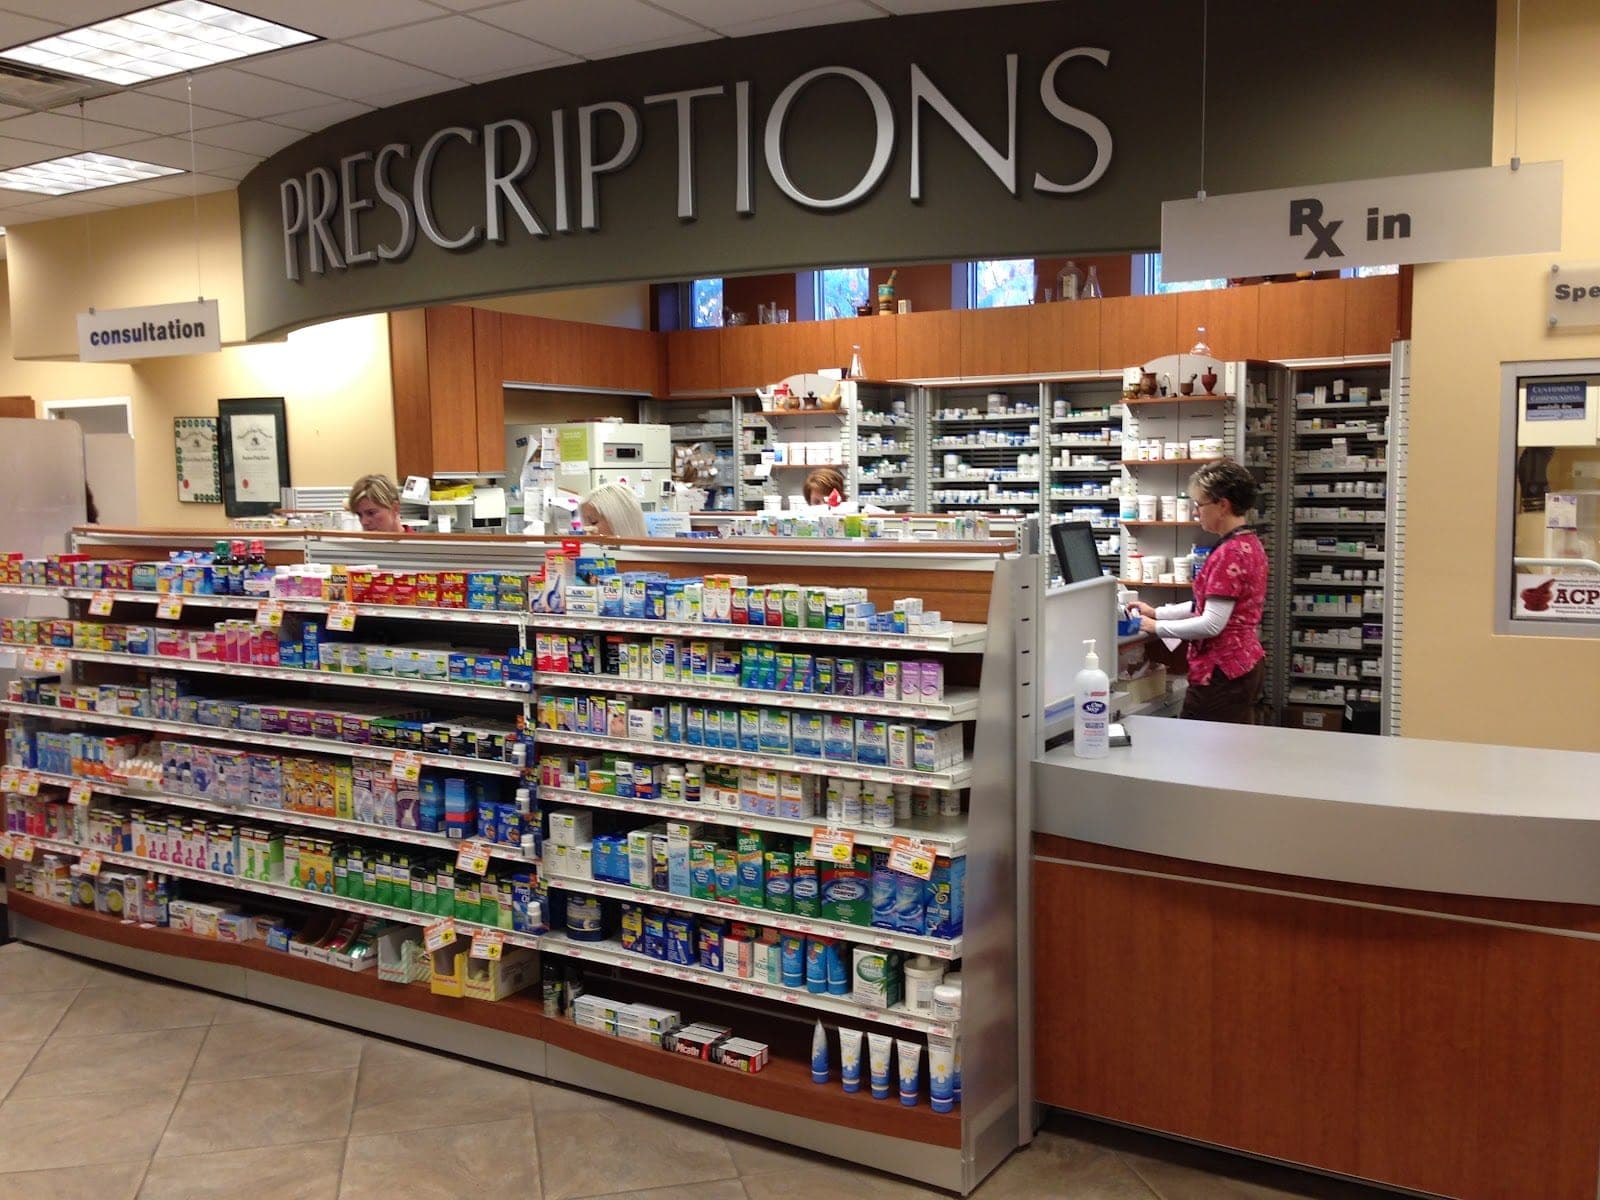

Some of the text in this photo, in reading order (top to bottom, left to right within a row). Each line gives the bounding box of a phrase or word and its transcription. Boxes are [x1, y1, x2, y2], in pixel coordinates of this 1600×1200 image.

[280, 46, 1113, 282] PRESCRIPTIONS
[1366, 207, 1411, 241] in
[90, 319, 205, 346] consultation
[1553, 589, 1600, 605] ACP
